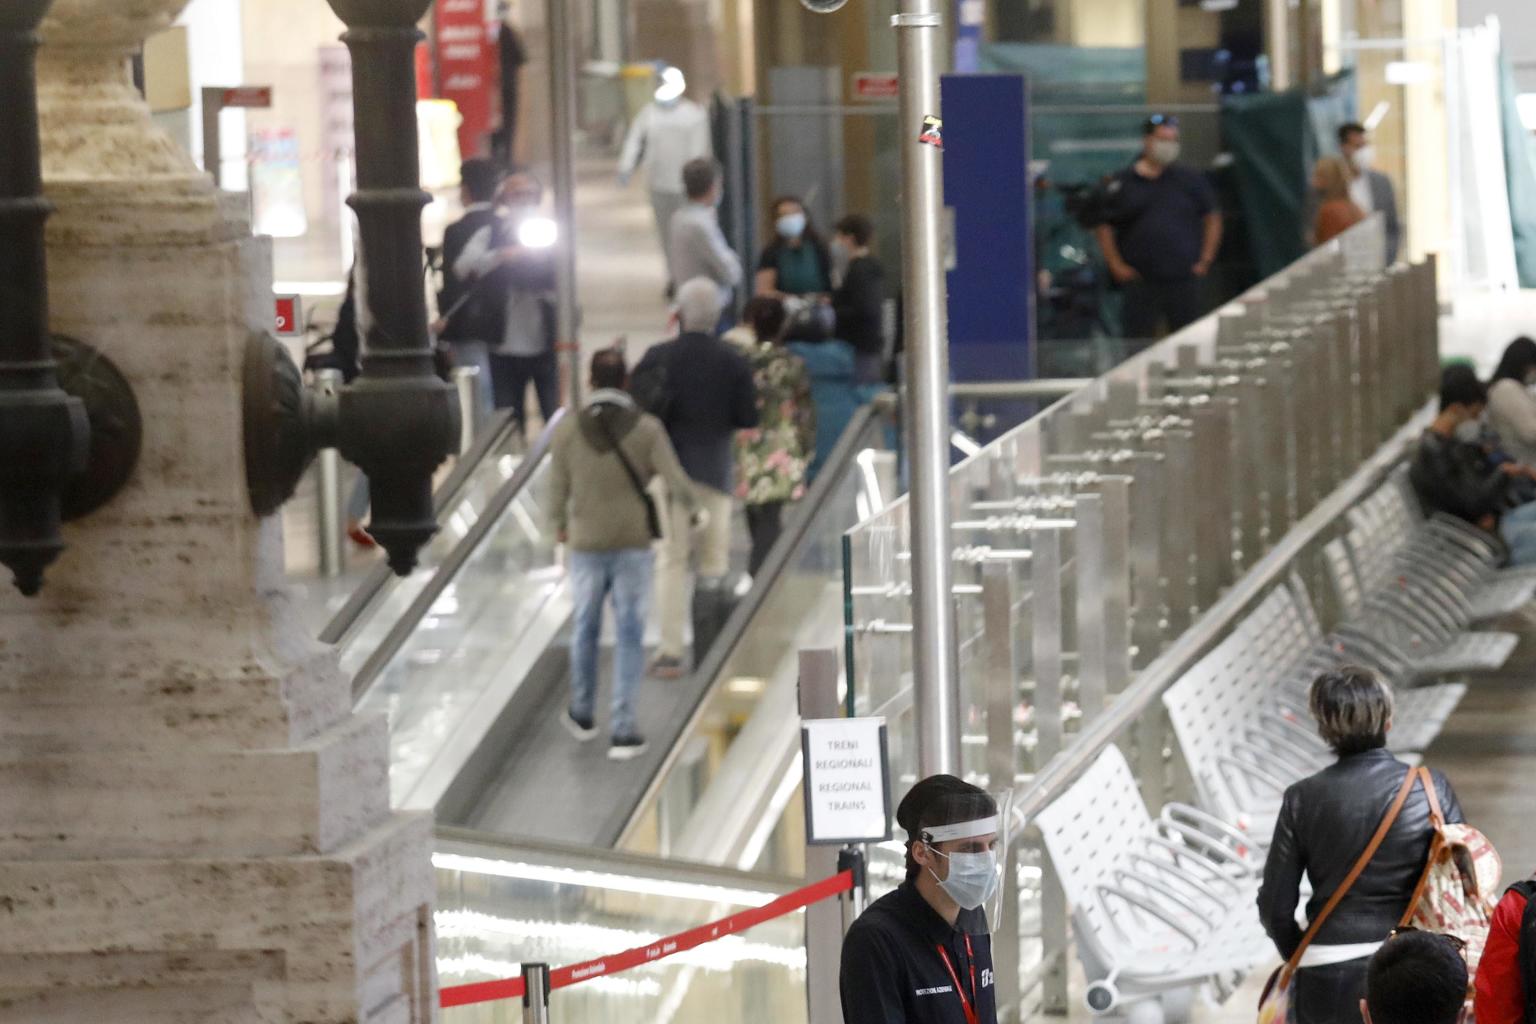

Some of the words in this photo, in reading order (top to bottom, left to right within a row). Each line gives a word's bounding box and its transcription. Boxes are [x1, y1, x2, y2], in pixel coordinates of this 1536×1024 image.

[828, 740, 858, 750] TRENI
[816, 759, 873, 769] REGIONALI
[819, 782, 872, 792] REGIONAL
[829, 801, 866, 810] TRAINS
